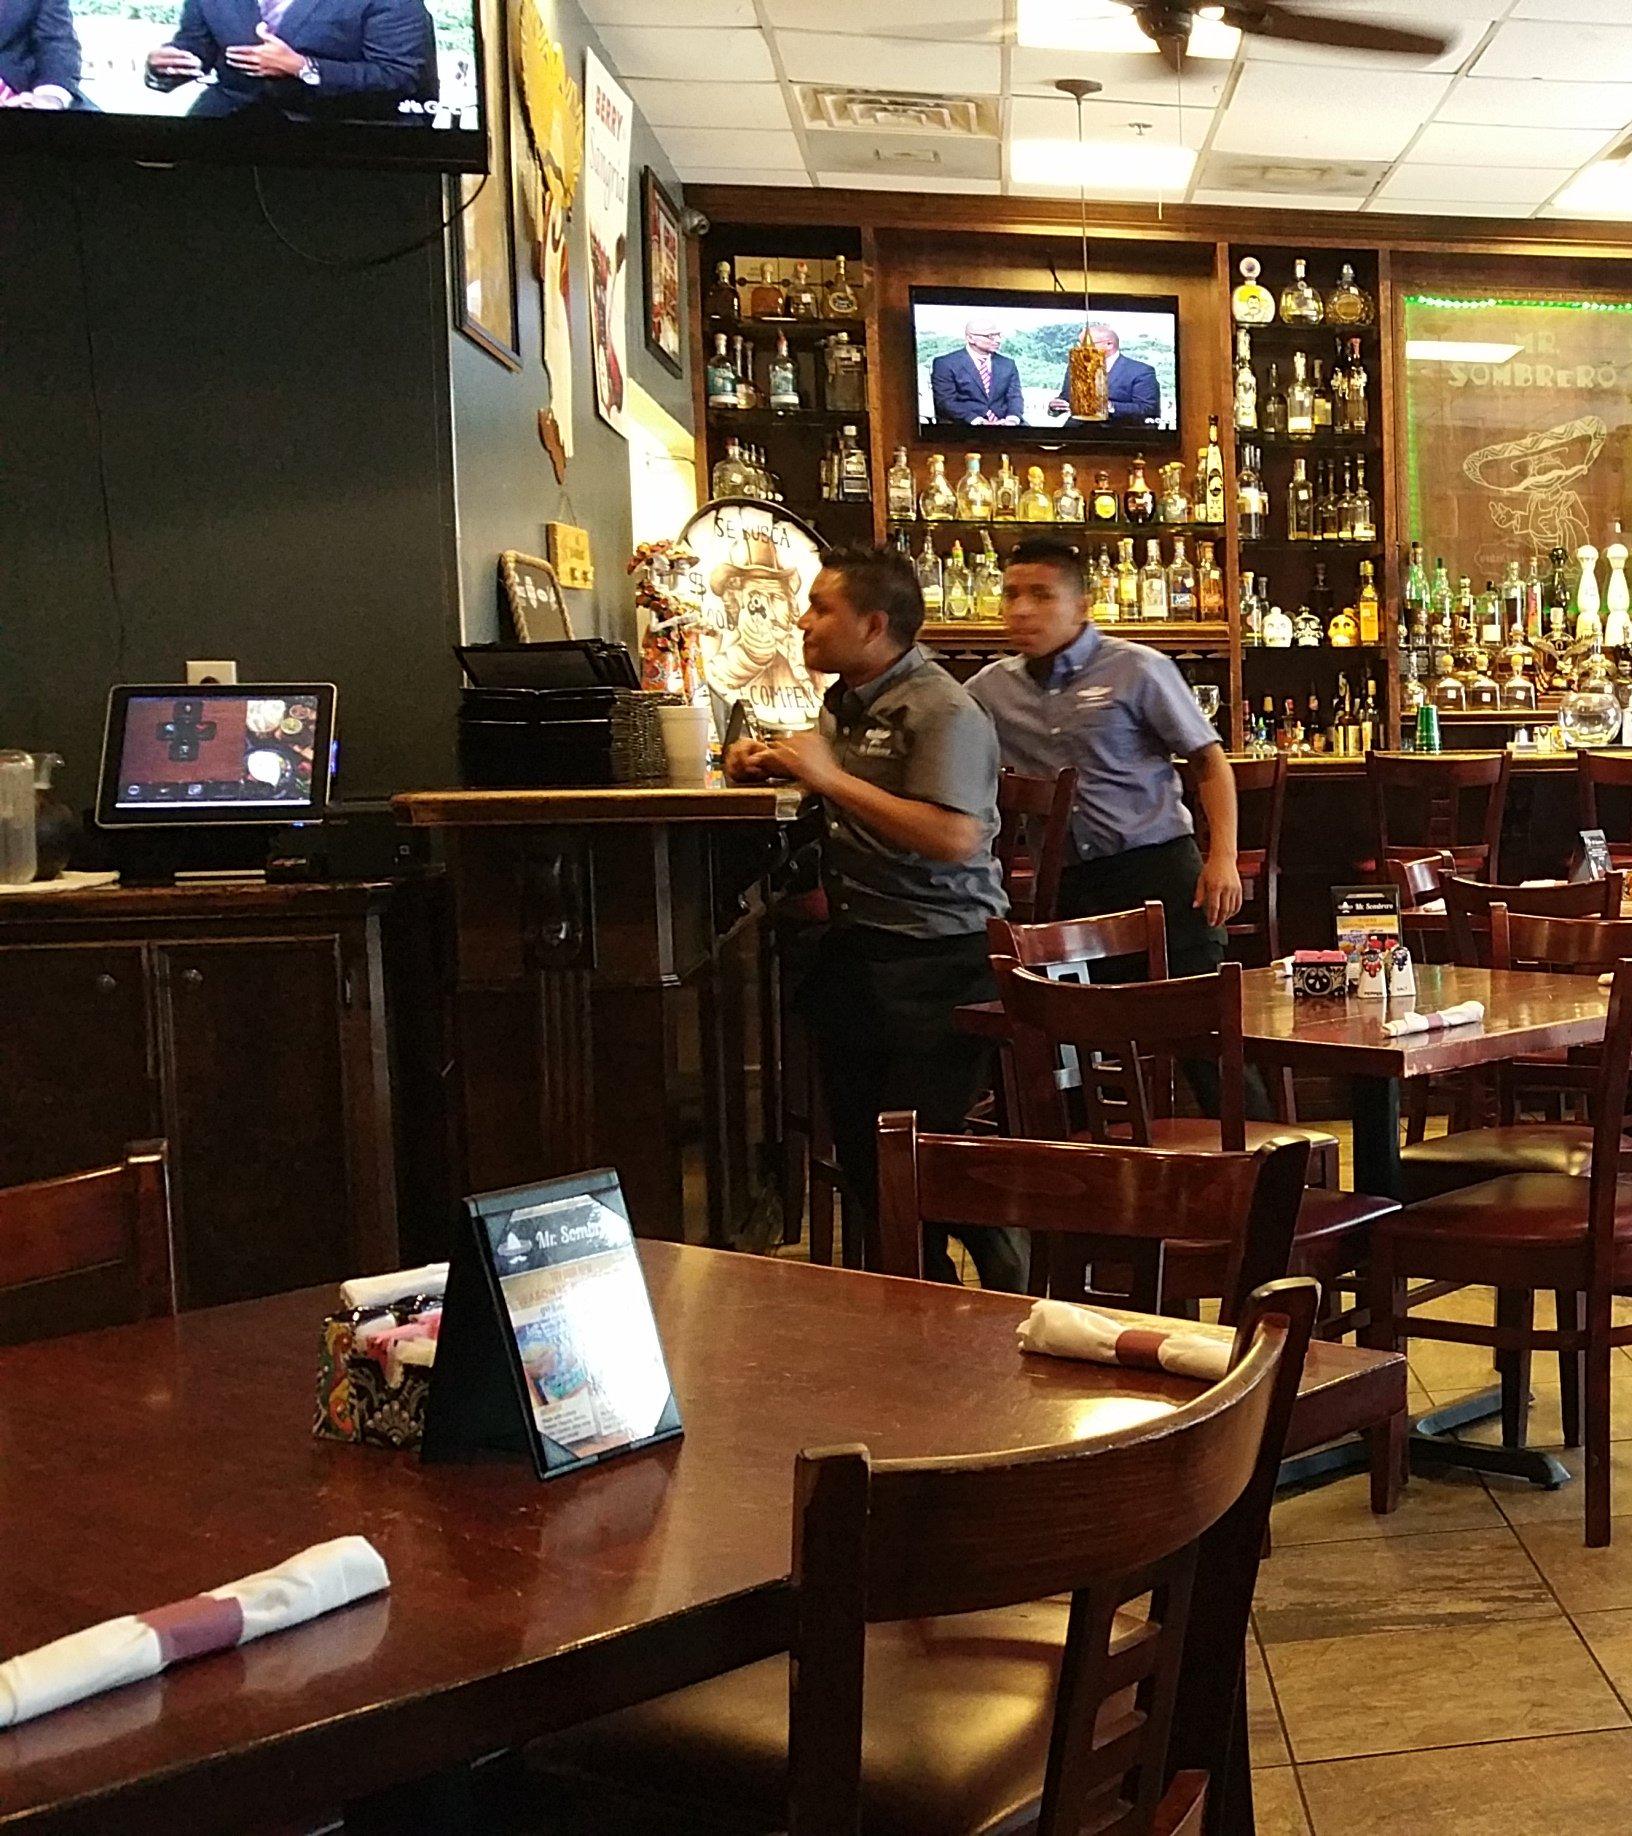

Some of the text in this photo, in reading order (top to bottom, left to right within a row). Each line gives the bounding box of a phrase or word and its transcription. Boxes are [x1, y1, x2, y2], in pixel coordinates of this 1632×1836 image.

[595, 84, 624, 142] BERRY
[1448, 362, 1617, 389] SOMBRERO
[714, 517, 791, 549] SE BUSCA
[535, 1230, 558, 1249] Mr.
